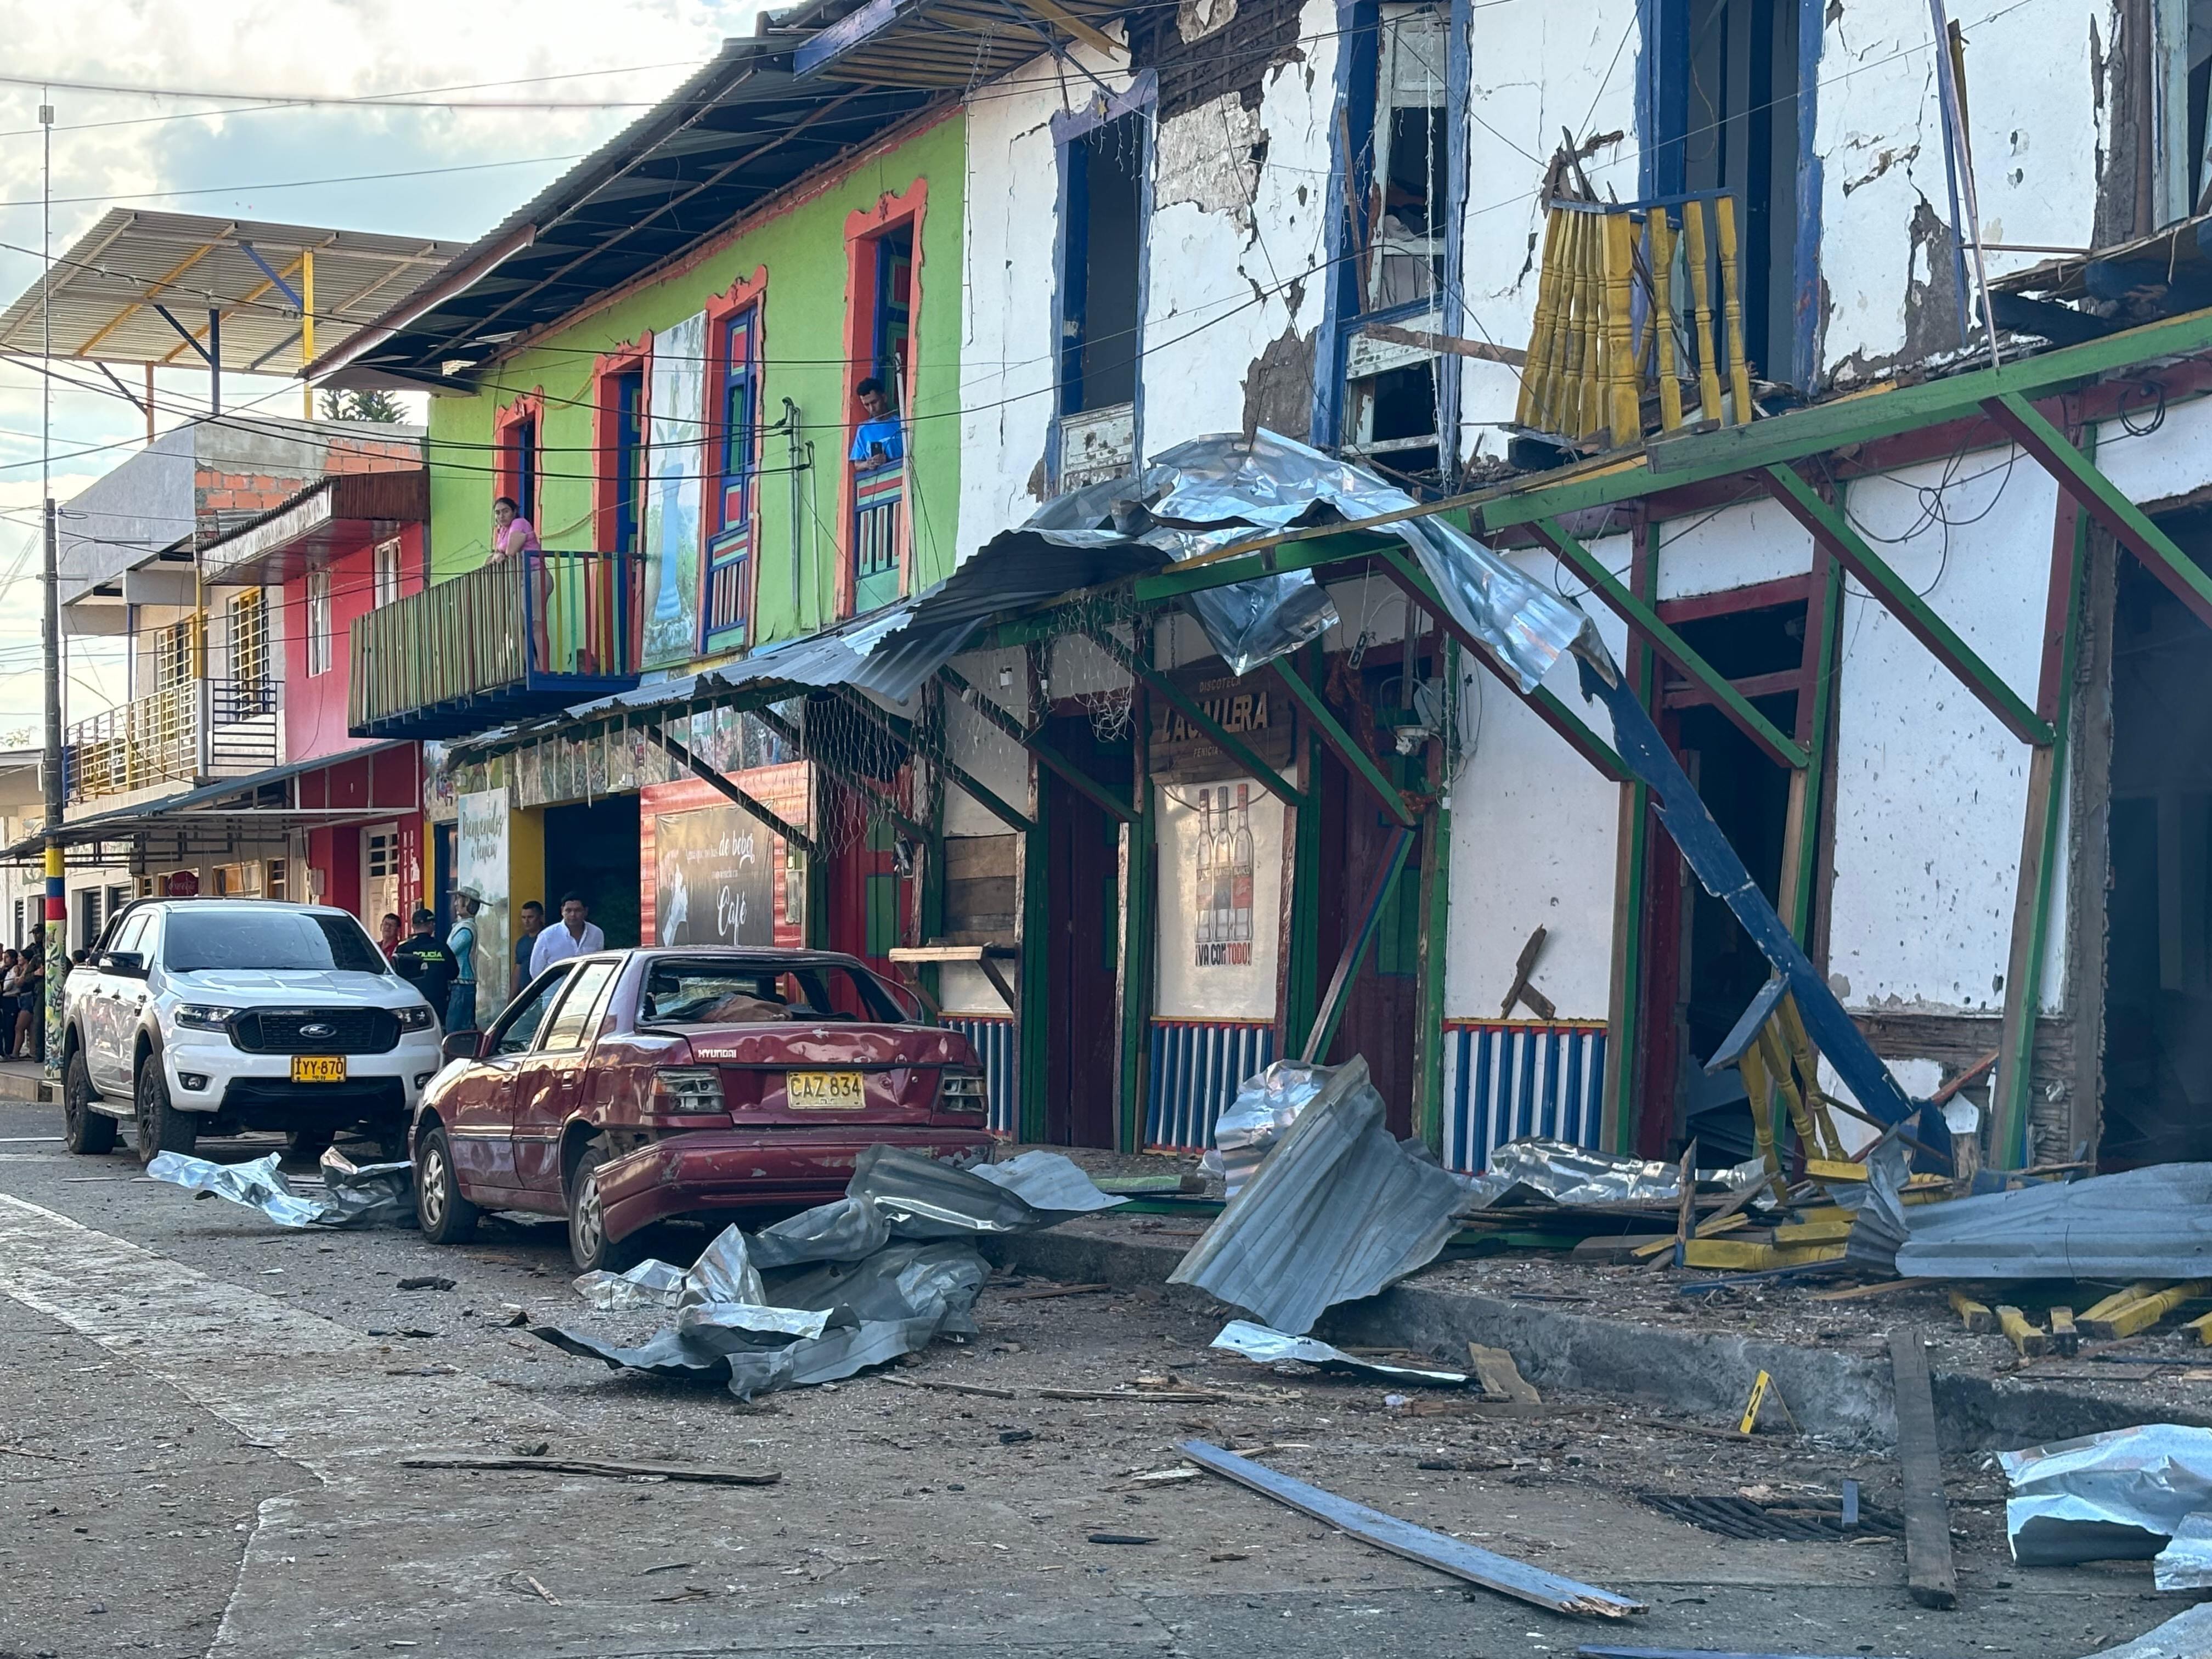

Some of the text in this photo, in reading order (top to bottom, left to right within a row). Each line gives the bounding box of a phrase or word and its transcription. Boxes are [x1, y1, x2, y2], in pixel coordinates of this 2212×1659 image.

[1199, 676, 1242, 692] DISCOTECA
[719, 831, 729, 856] de
[717, 885, 747, 946] Café
[1211, 943, 1226, 966] CON
[698, 1049, 737, 1058] HYUNDAI
[791, 1076, 861, 1097] CAZ 834
[1747, 1385, 1761, 1418] 2
